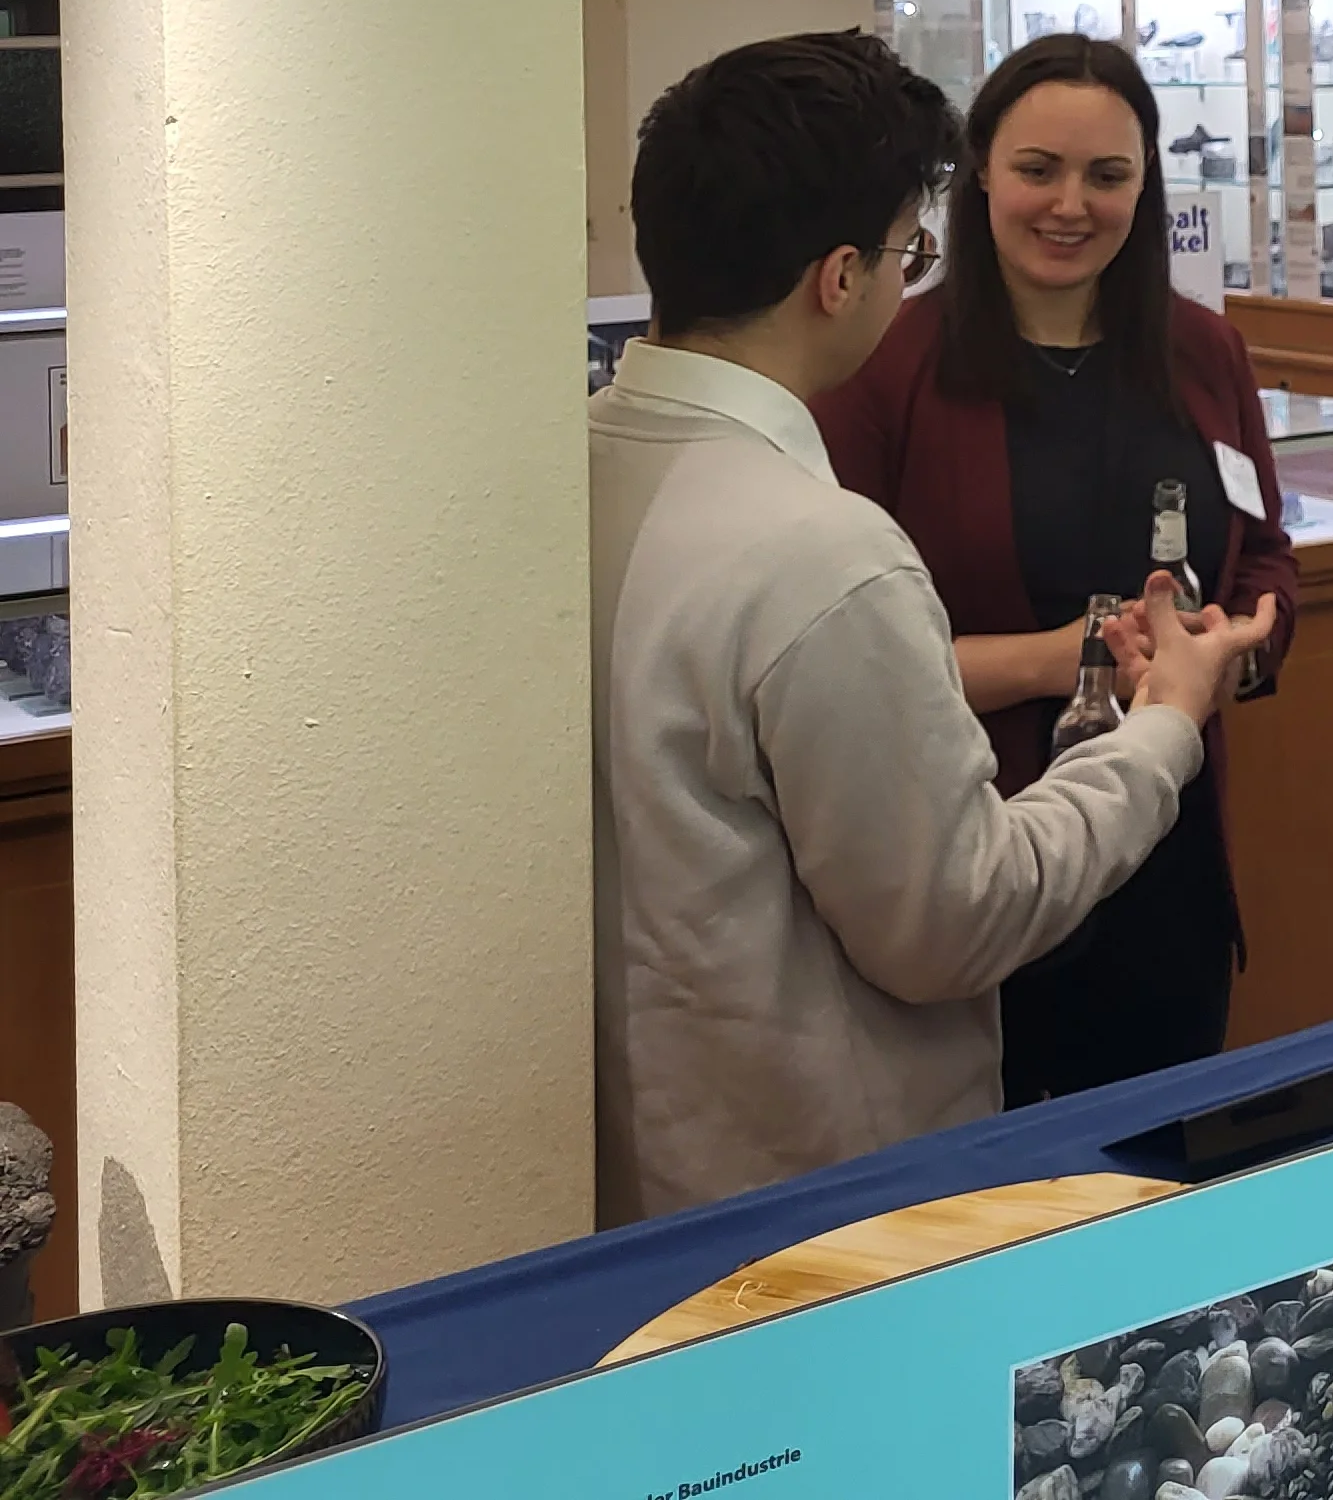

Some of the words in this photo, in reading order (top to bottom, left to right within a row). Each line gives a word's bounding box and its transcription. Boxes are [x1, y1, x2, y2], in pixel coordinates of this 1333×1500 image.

[1165, 204, 1208, 229] alt
[1172, 230, 1209, 253] kel
[678, 1448, 802, 1500] Bauindustrie
